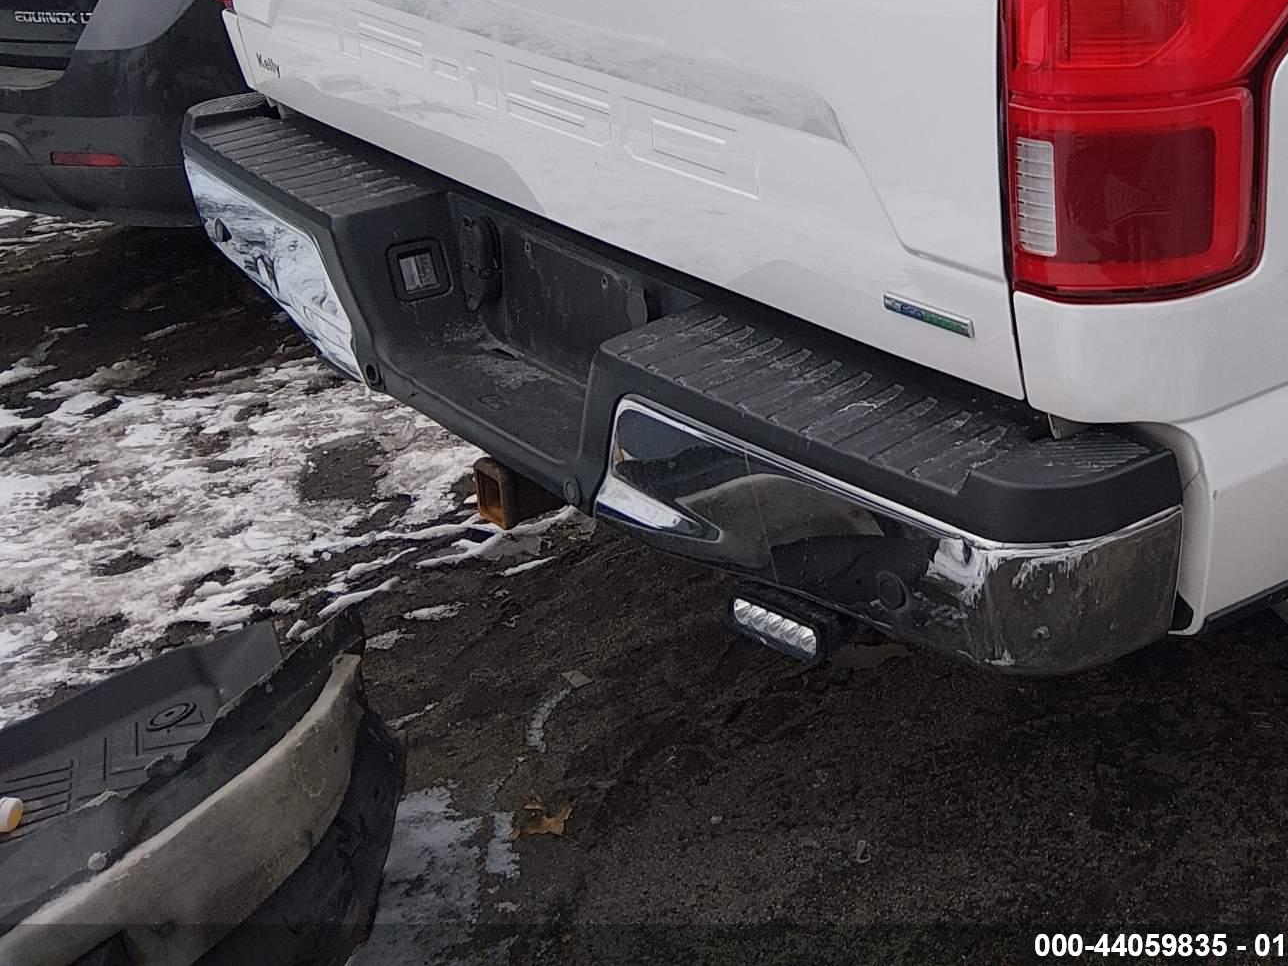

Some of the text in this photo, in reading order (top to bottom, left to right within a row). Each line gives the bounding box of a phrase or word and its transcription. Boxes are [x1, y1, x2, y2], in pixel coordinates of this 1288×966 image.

[14, 11, 78, 24] EQUINOX
[255, 52, 281, 79] Kelly
[338, 6, 760, 201] F-150
